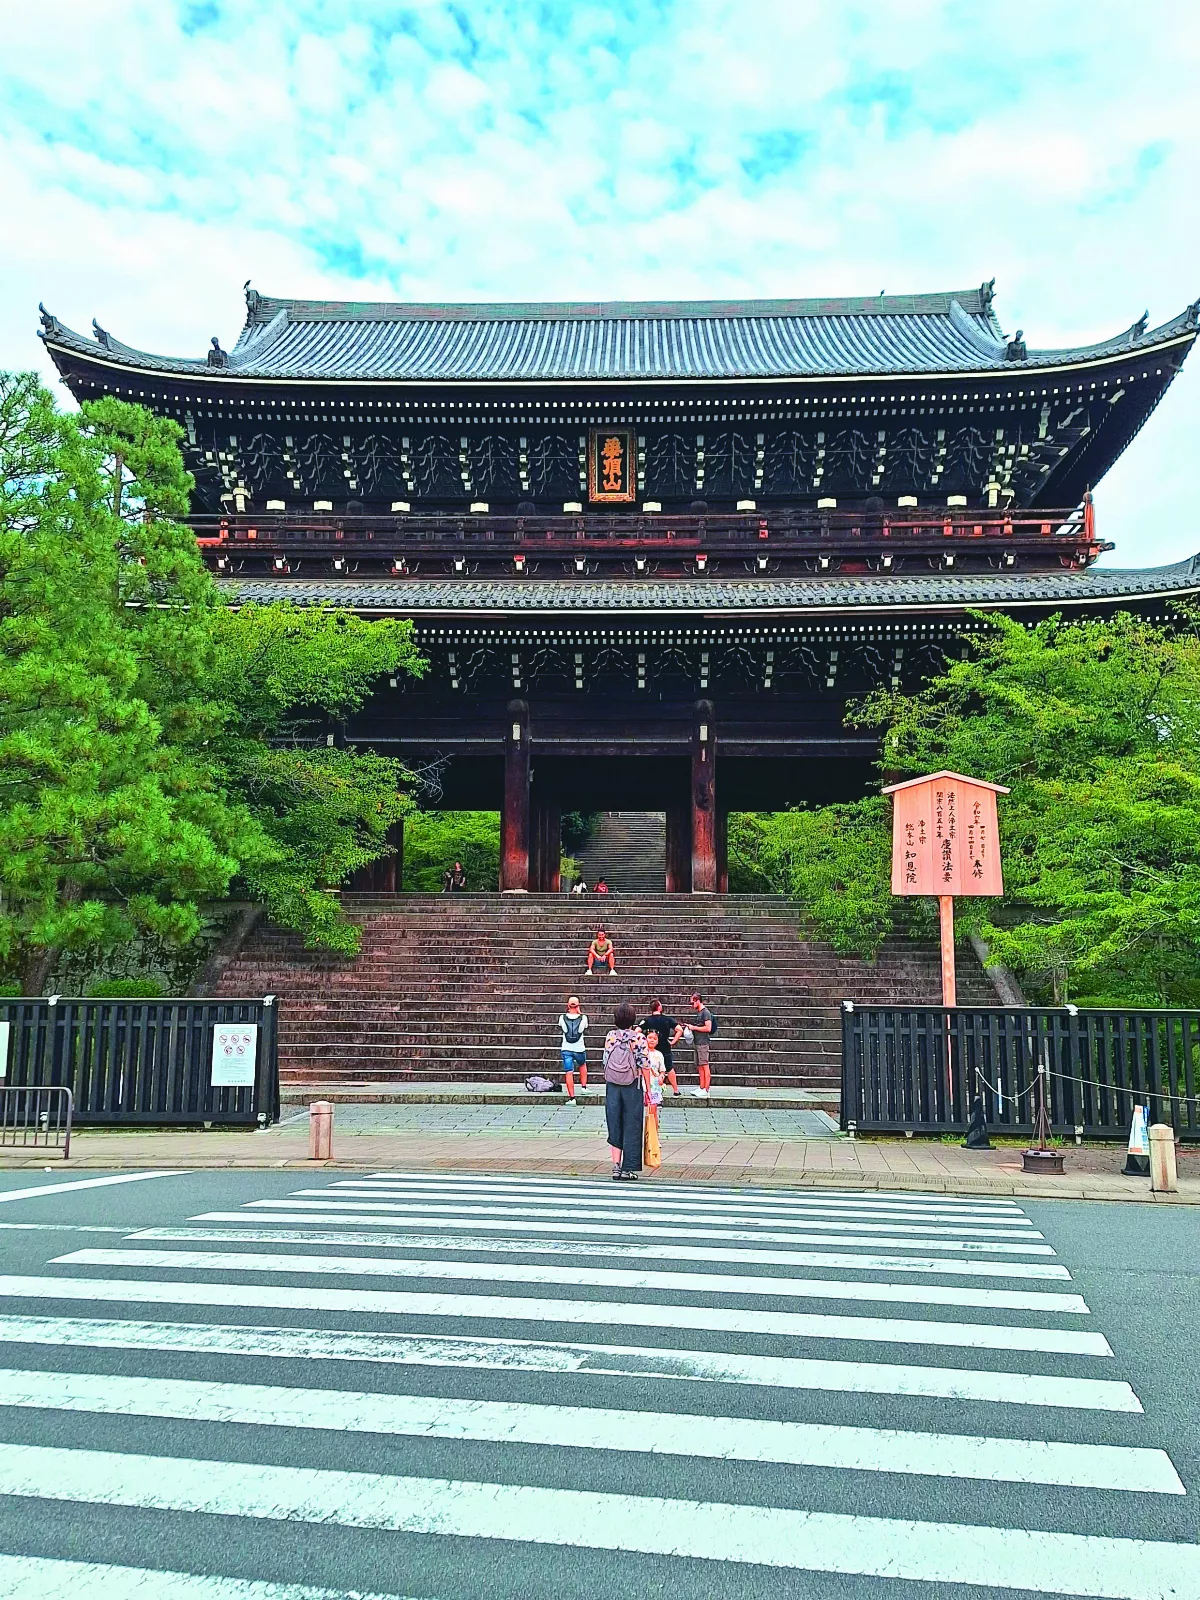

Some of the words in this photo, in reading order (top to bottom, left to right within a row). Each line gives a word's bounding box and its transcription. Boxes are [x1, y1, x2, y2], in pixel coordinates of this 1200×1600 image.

[936, 791, 944, 839] 開宗八百五十年
